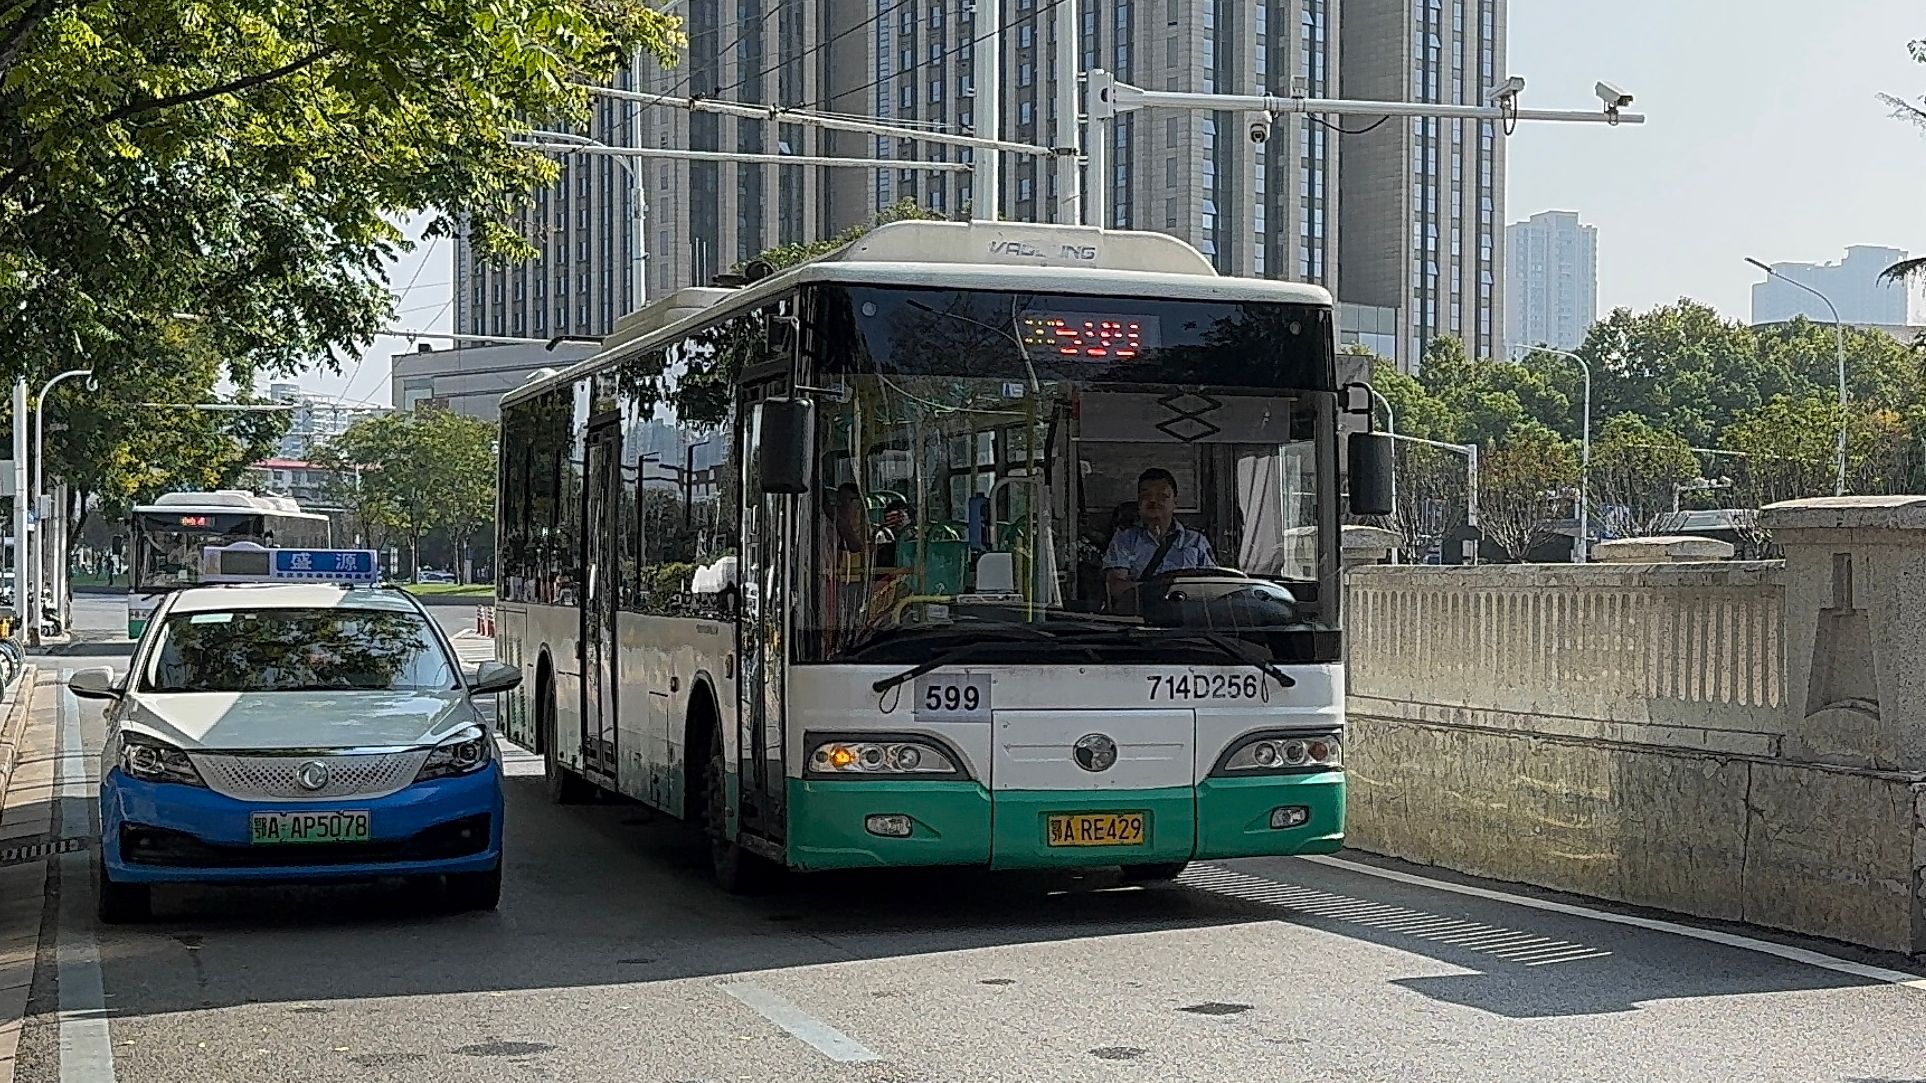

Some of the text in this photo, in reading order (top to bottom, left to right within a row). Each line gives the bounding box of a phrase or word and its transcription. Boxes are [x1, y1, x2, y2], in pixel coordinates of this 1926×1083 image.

[290, 553, 358, 570] 盛源
[926, 685, 980, 711] 599
[1147, 674, 1257, 699] 714D256
